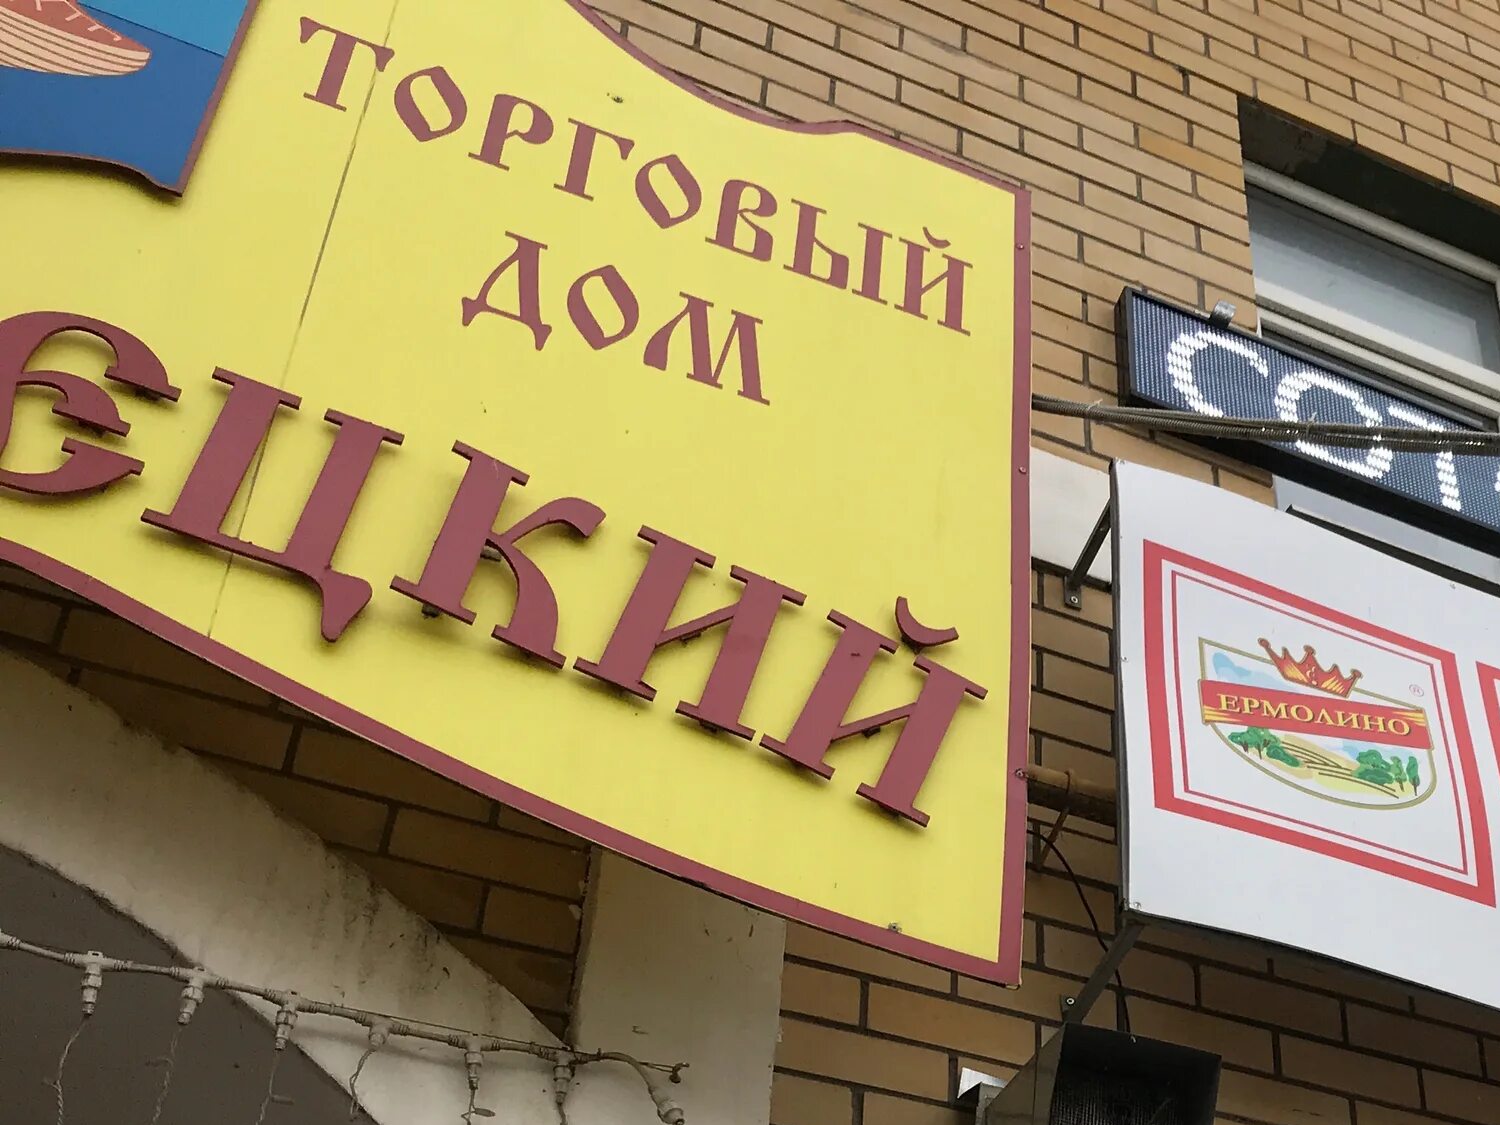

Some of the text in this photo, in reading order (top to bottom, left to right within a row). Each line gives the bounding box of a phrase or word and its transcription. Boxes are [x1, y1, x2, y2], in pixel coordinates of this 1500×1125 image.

[300, 16, 974, 336] ТОРГОВЫЙ
[461, 230, 770, 405] ДОМ
[1216, 693, 1411, 737] ЕРМОЛИНО
